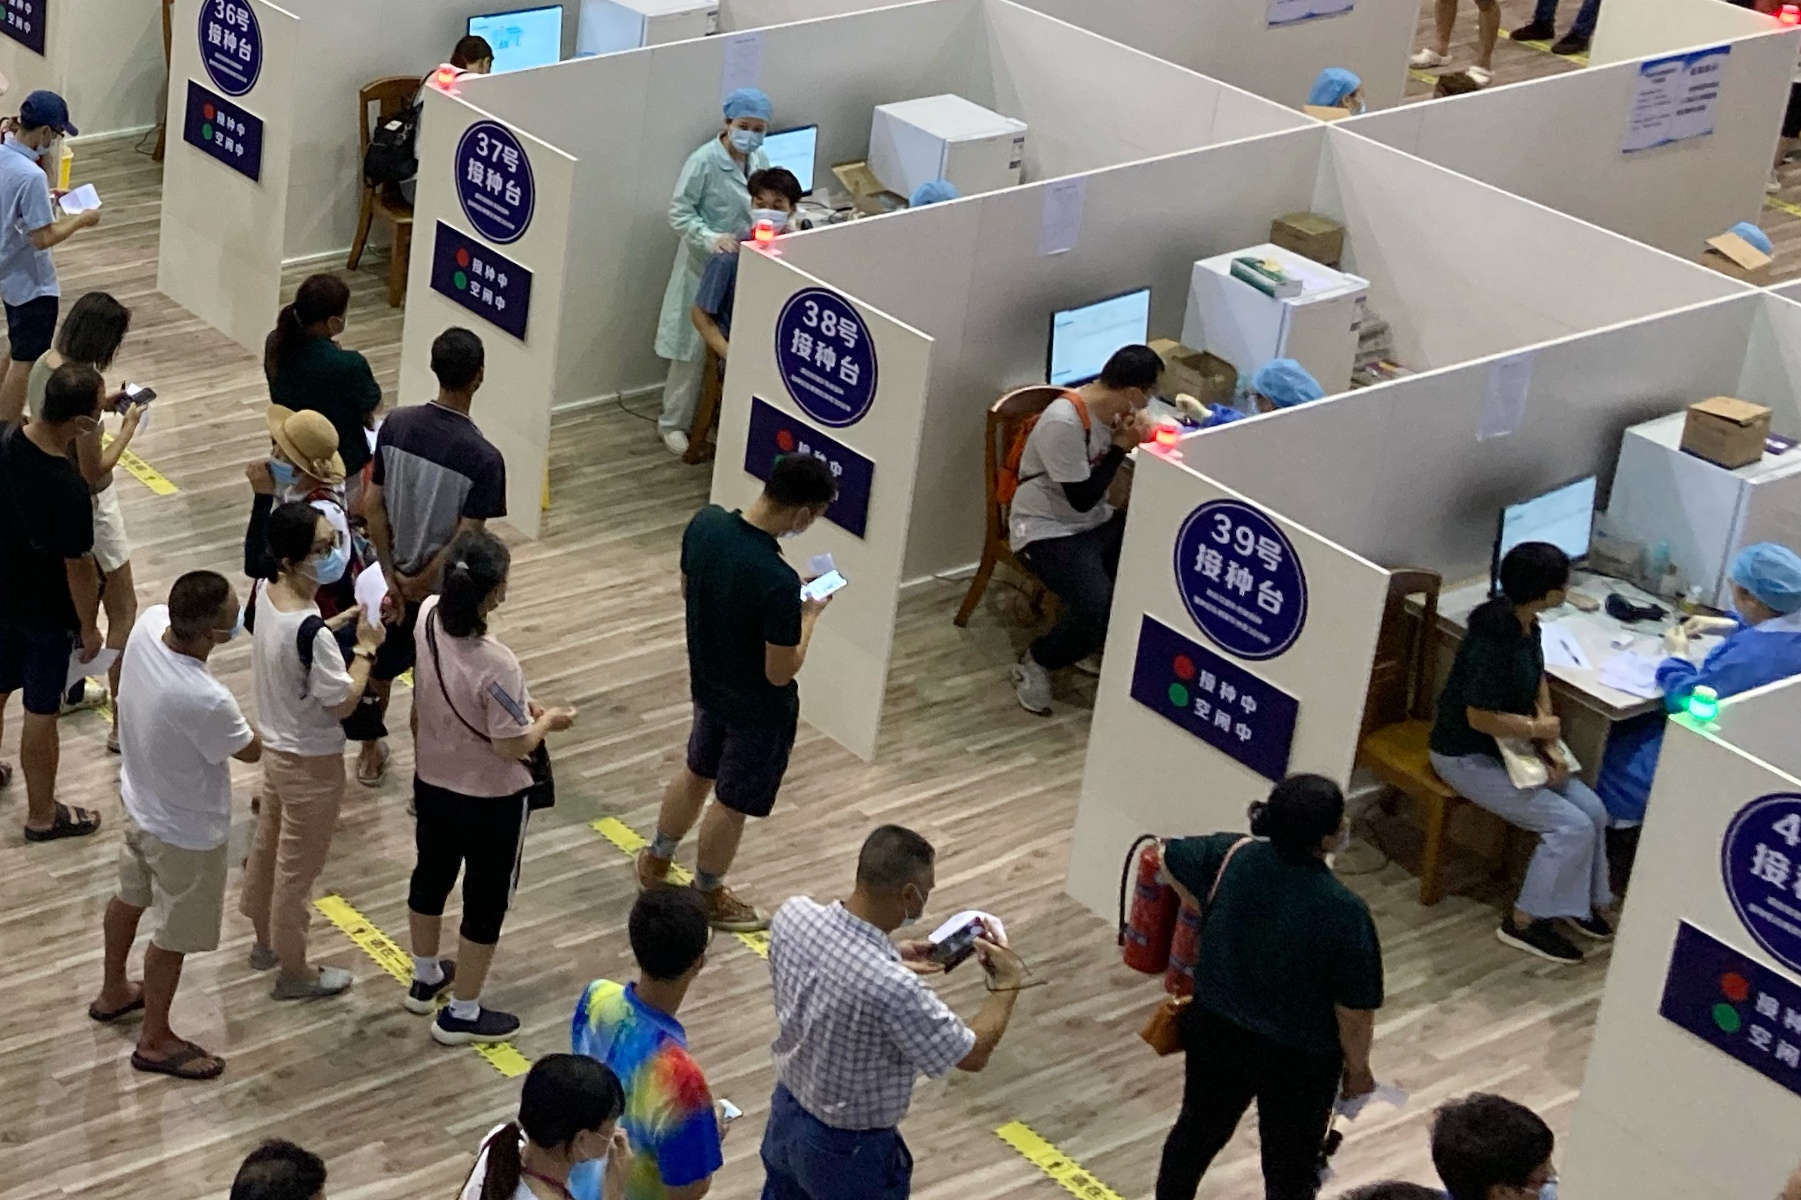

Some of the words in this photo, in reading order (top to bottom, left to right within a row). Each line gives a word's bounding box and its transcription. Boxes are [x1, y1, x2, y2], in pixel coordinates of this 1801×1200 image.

[207, 21, 253, 62] 接种台
[475, 132, 520, 174] 37号
[466, 158, 522, 208] 接种台
[469, 280, 507, 312] 空闲中
[471, 256, 509, 290] 接种中
[801, 300, 859, 349] 38号
[790, 327, 861, 386] 接种台
[1210, 513, 1283, 572] 39号
[1193, 543, 1284, 615] 接种台
[1199, 668, 1258, 714] 接种中
[1193, 698, 1253, 742] 空闲中
